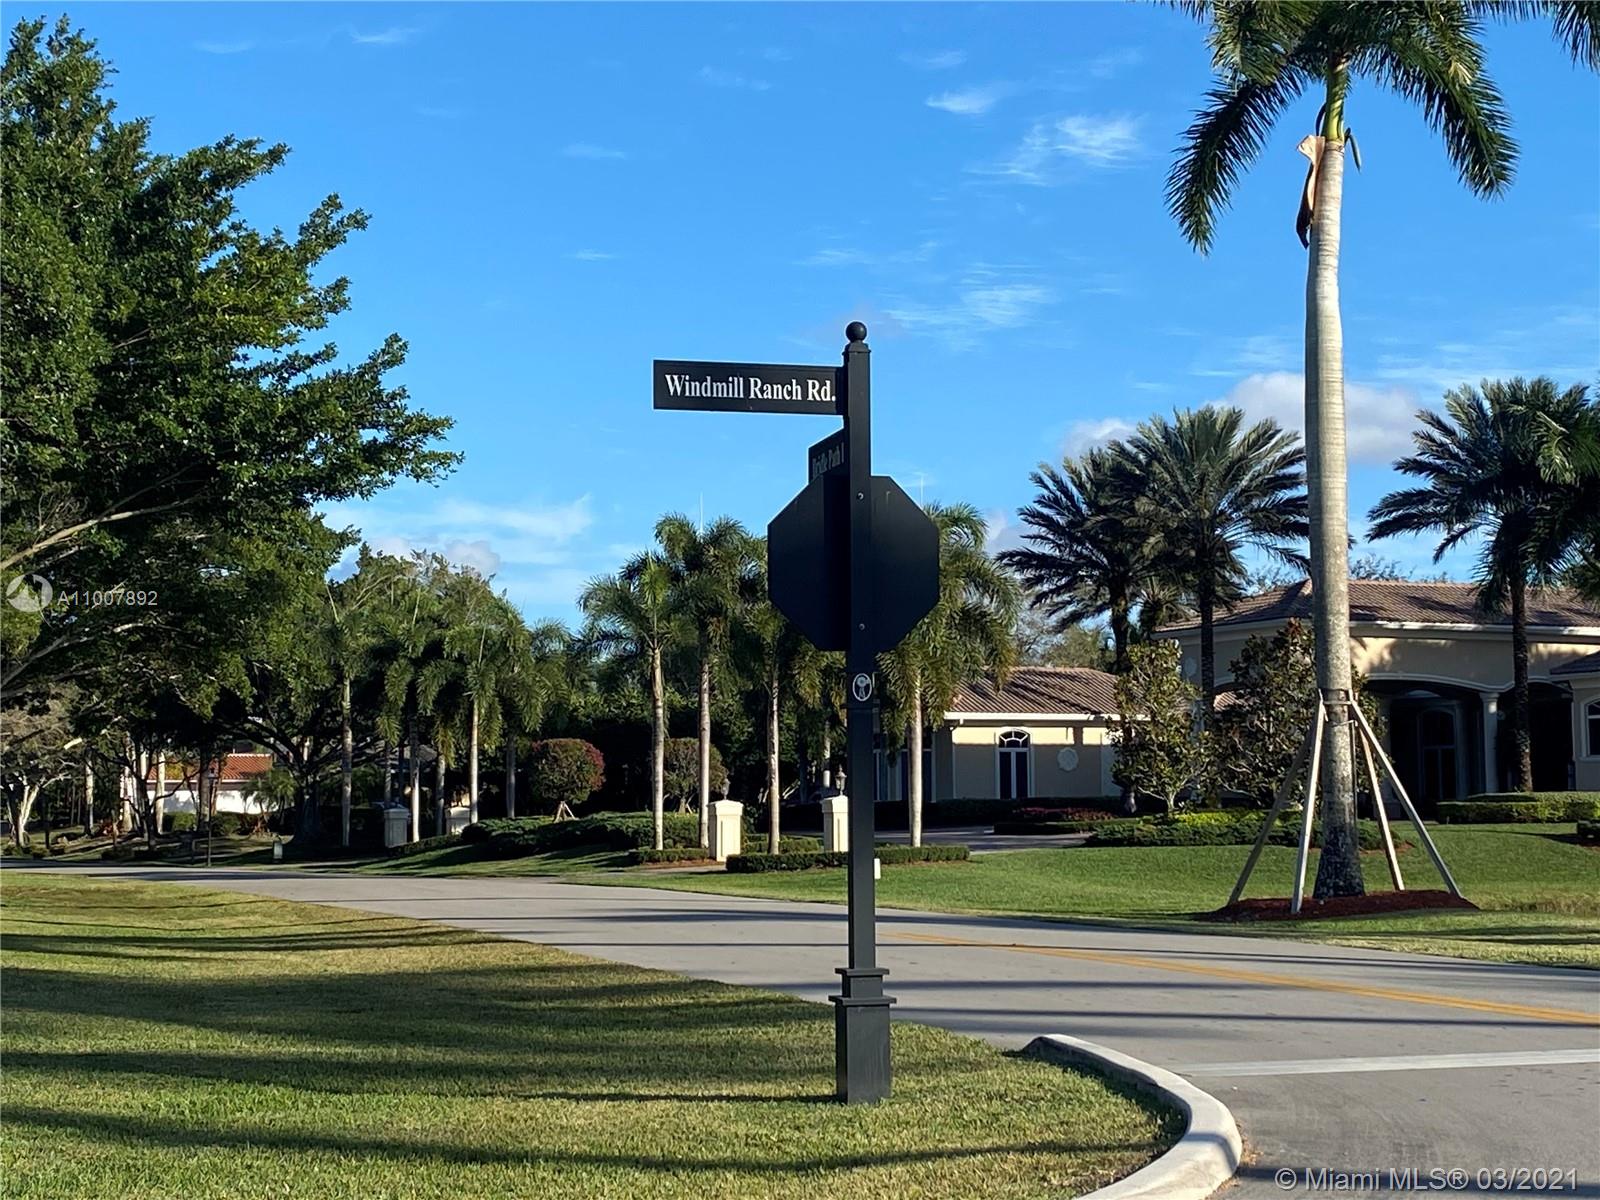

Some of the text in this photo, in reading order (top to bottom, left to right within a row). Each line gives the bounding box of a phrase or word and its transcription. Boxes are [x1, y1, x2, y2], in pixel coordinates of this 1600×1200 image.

[665, 374, 836, 401] Windmill Ranch Rd.
